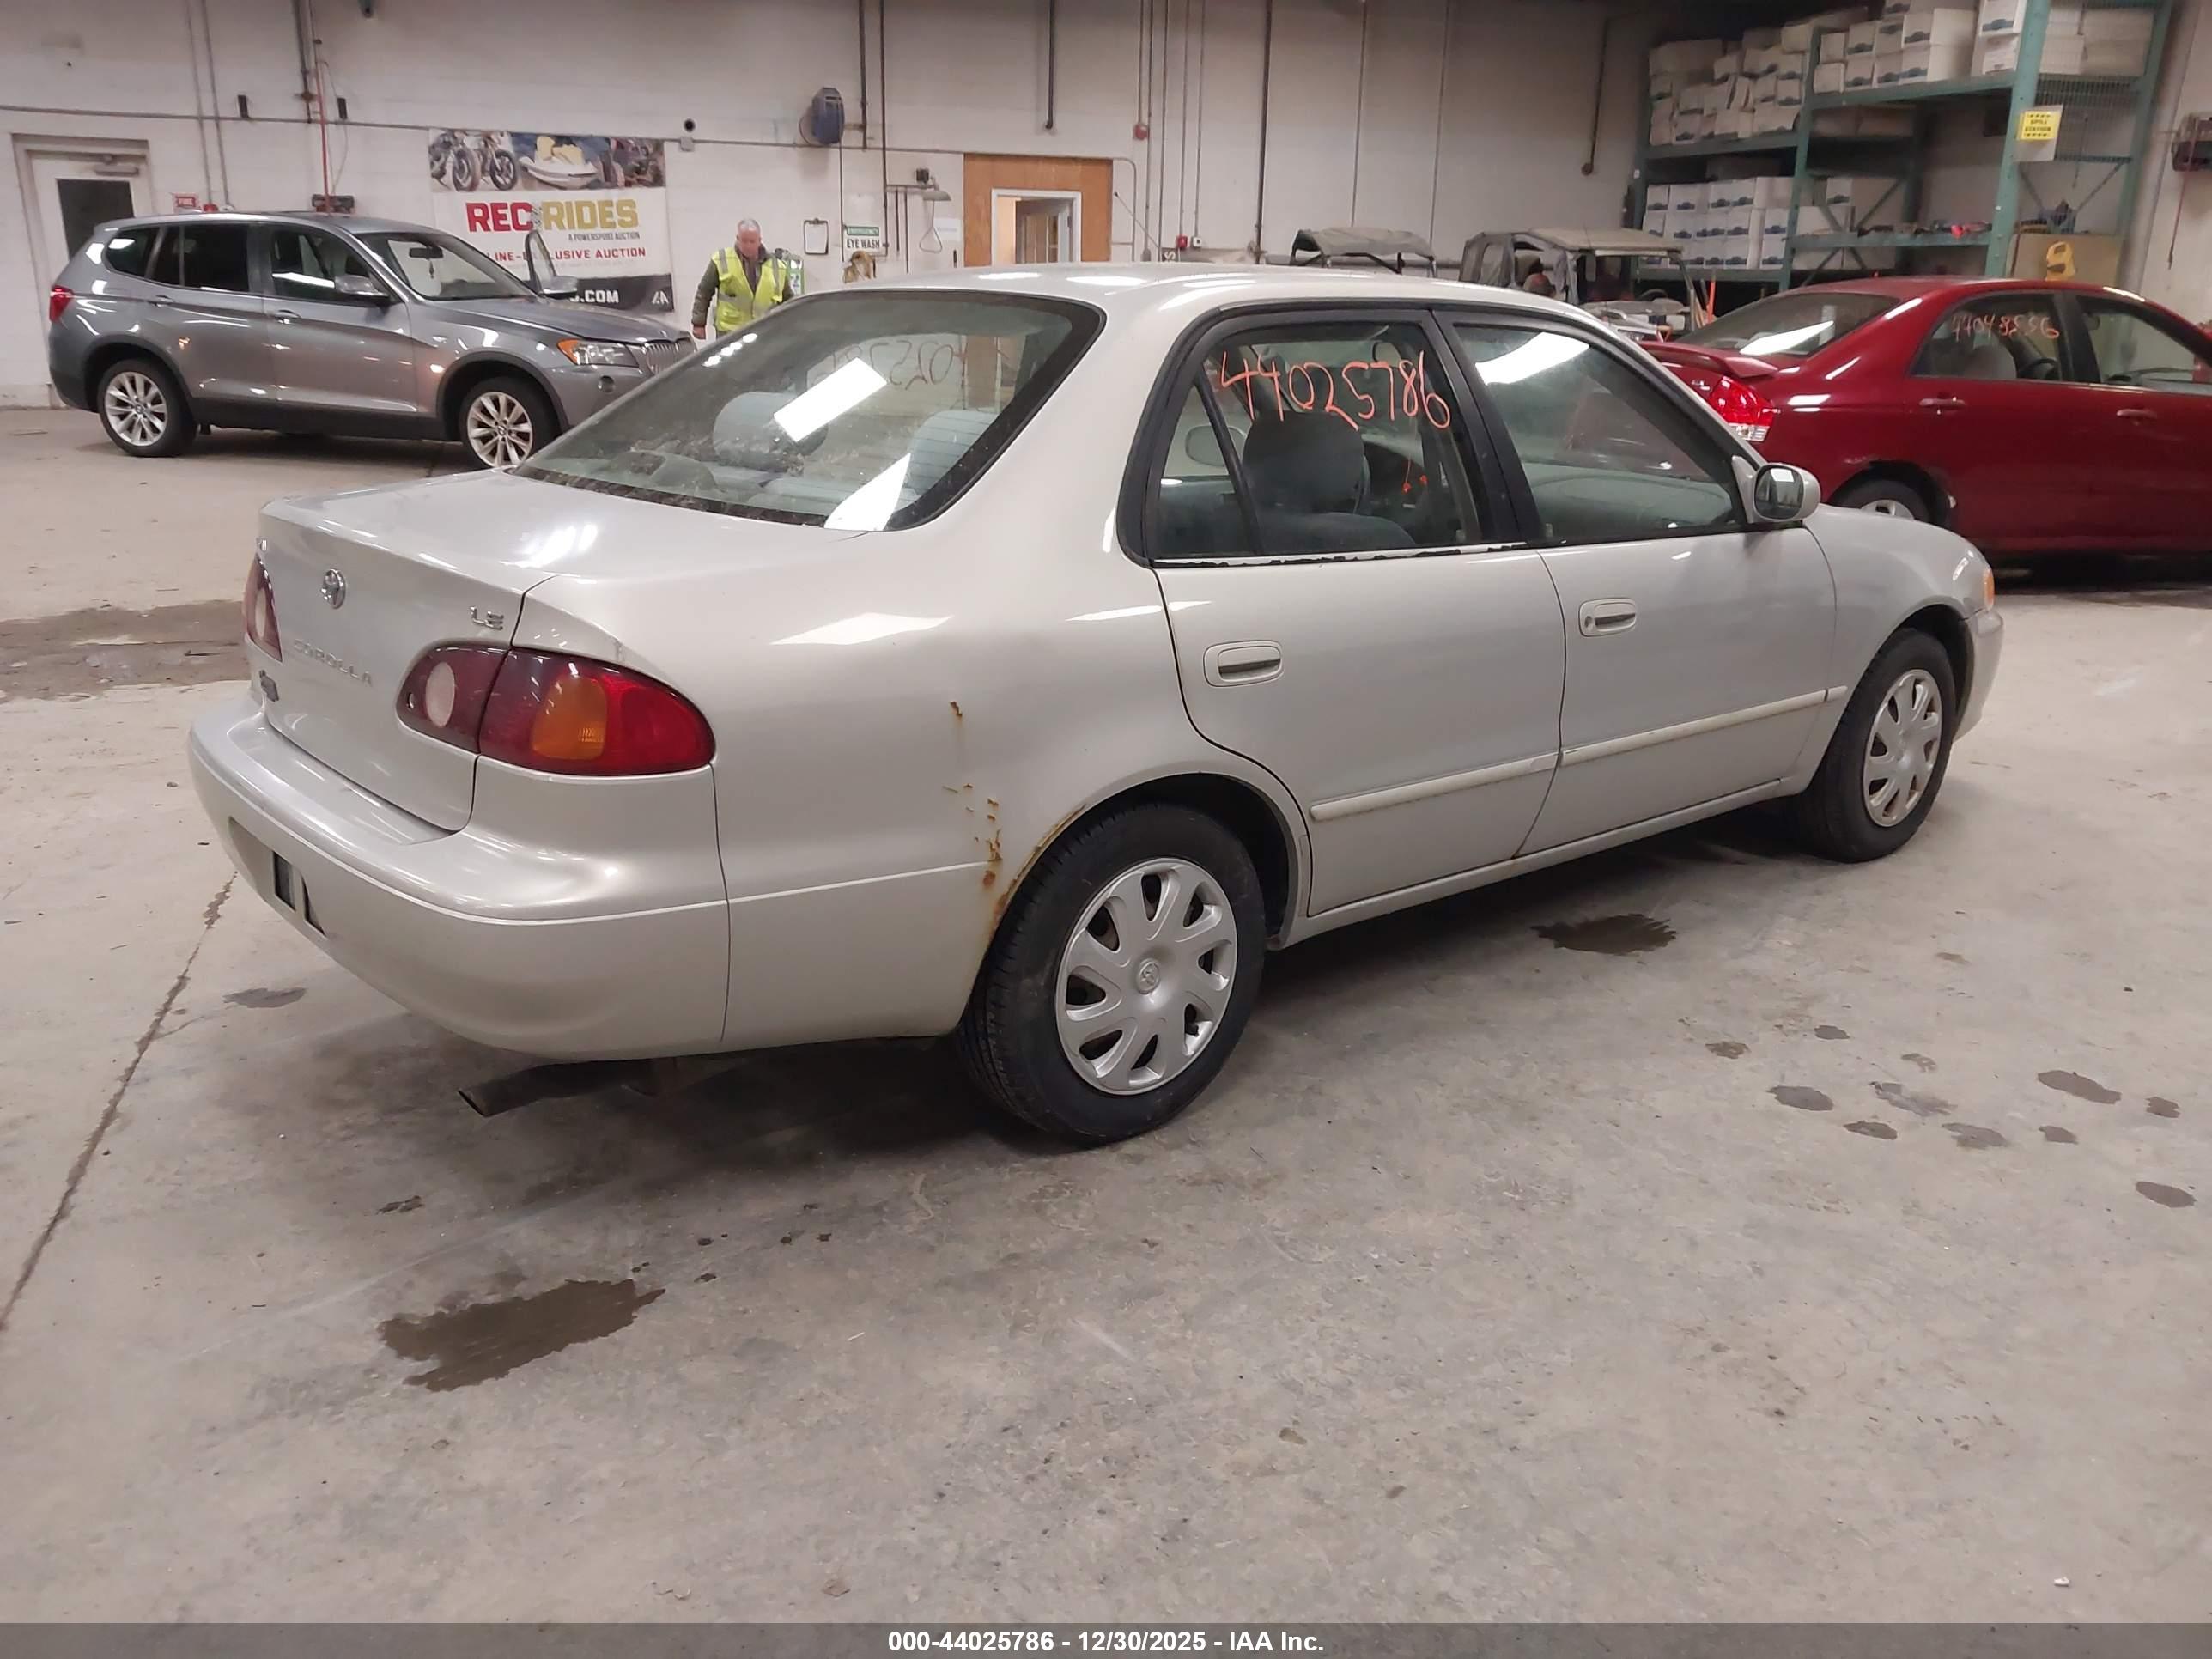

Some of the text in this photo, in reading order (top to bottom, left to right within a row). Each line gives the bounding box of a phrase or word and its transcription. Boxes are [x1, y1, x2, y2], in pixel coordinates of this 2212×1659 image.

[541, 198, 640, 231] RIDES
[615, 231, 641, 241] AUCTION
[847, 238, 880, 249] EYE WASH
[595, 246, 647, 258] AUCTION
[1220, 350, 1451, 431] 44025786
[470, 606, 504, 631] LE
[294, 638, 374, 688] COROLLA
